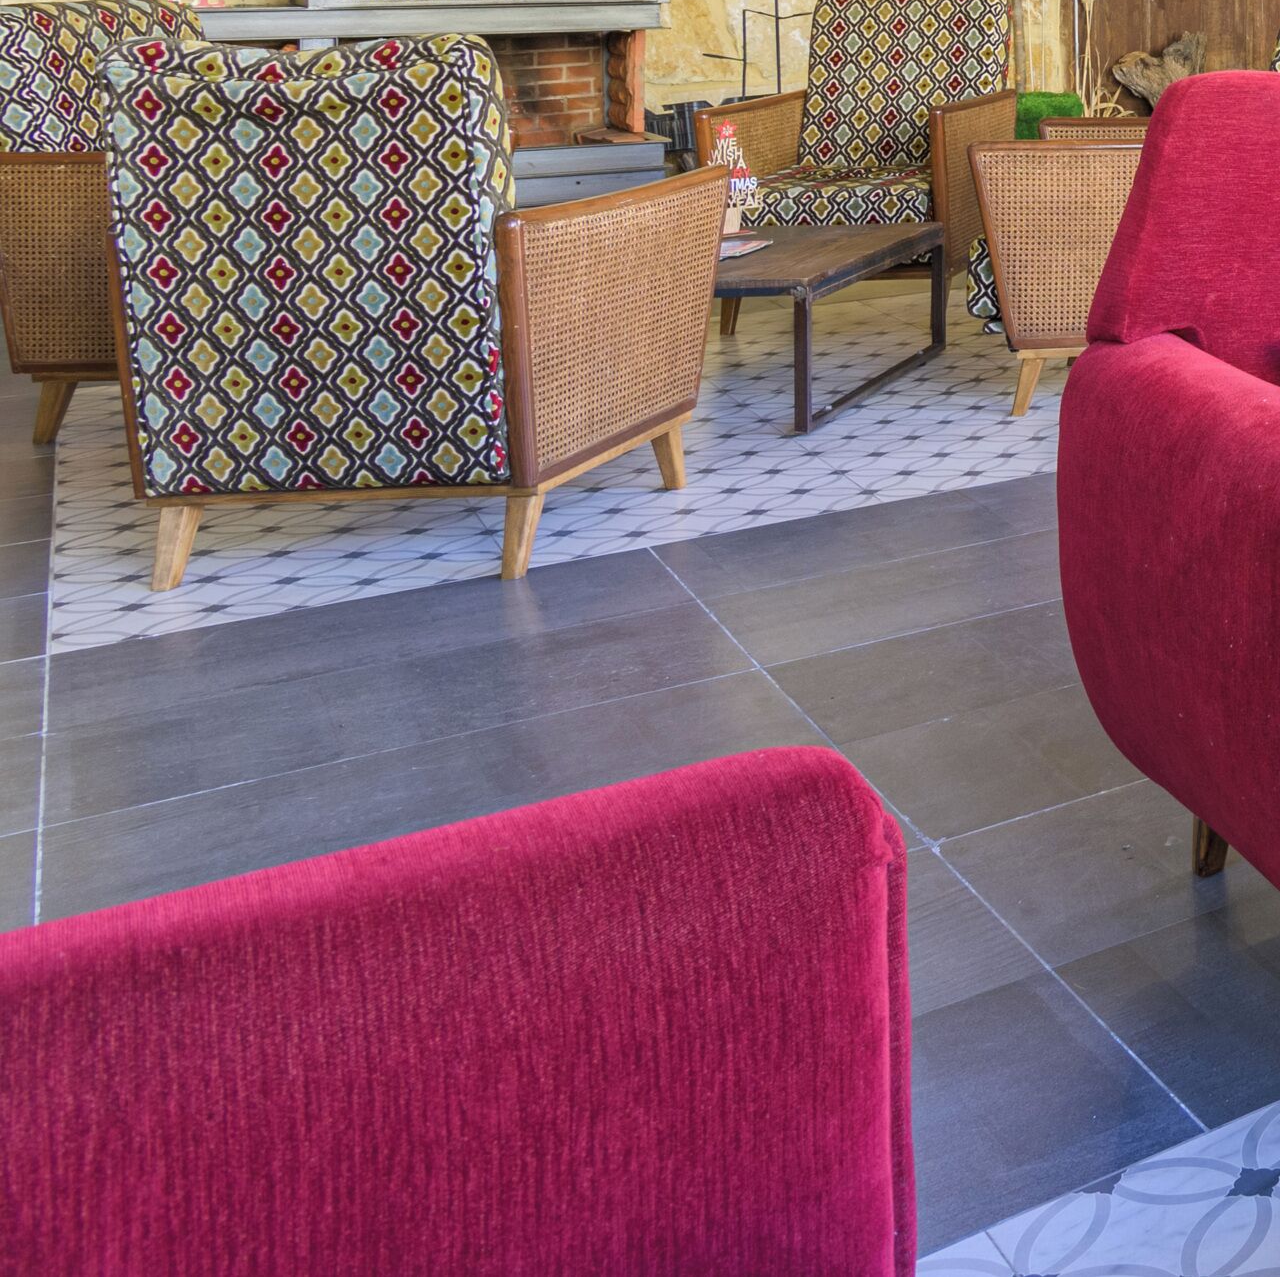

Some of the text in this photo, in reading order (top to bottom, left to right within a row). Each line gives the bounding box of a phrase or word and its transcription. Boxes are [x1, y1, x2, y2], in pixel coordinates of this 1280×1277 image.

[716, 137, 737, 150] WE
[711, 147, 743, 161] WISH
[737, 157, 747, 170] A
